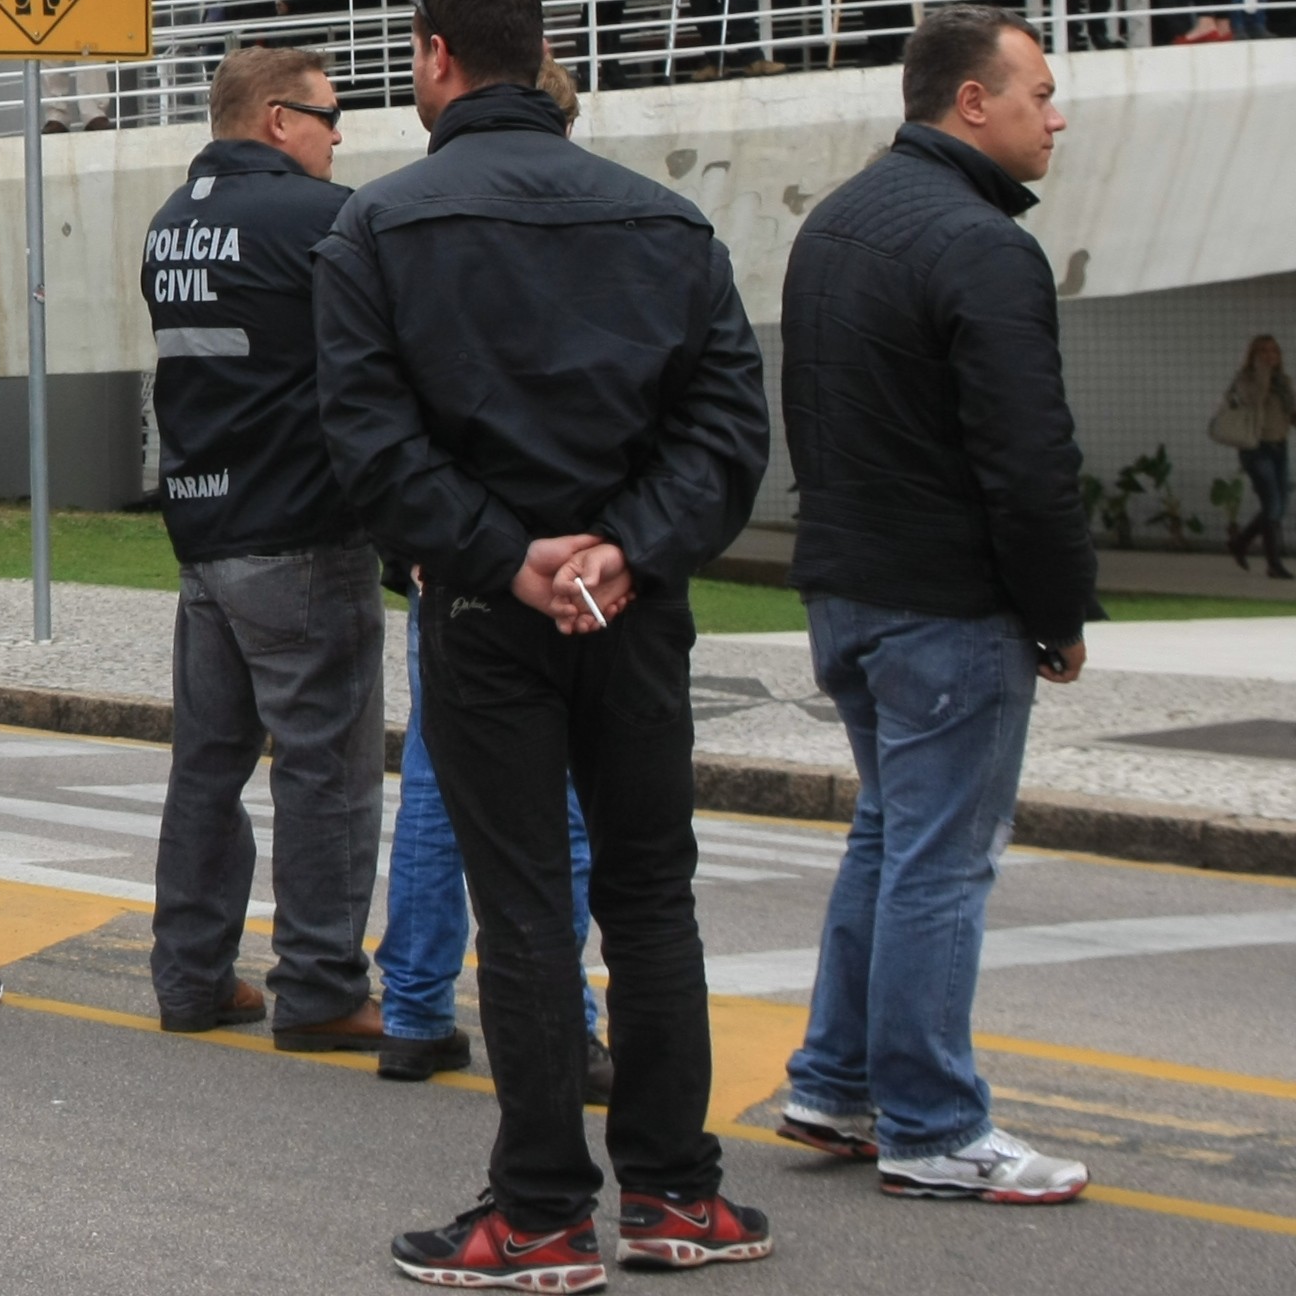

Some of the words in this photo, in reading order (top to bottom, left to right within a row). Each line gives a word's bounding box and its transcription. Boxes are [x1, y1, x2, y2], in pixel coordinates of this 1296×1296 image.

[145, 218, 241, 263] POLÍCIA
[154, 268, 219, 303] CIVIL
[166, 468, 229, 500] PARANÁ
